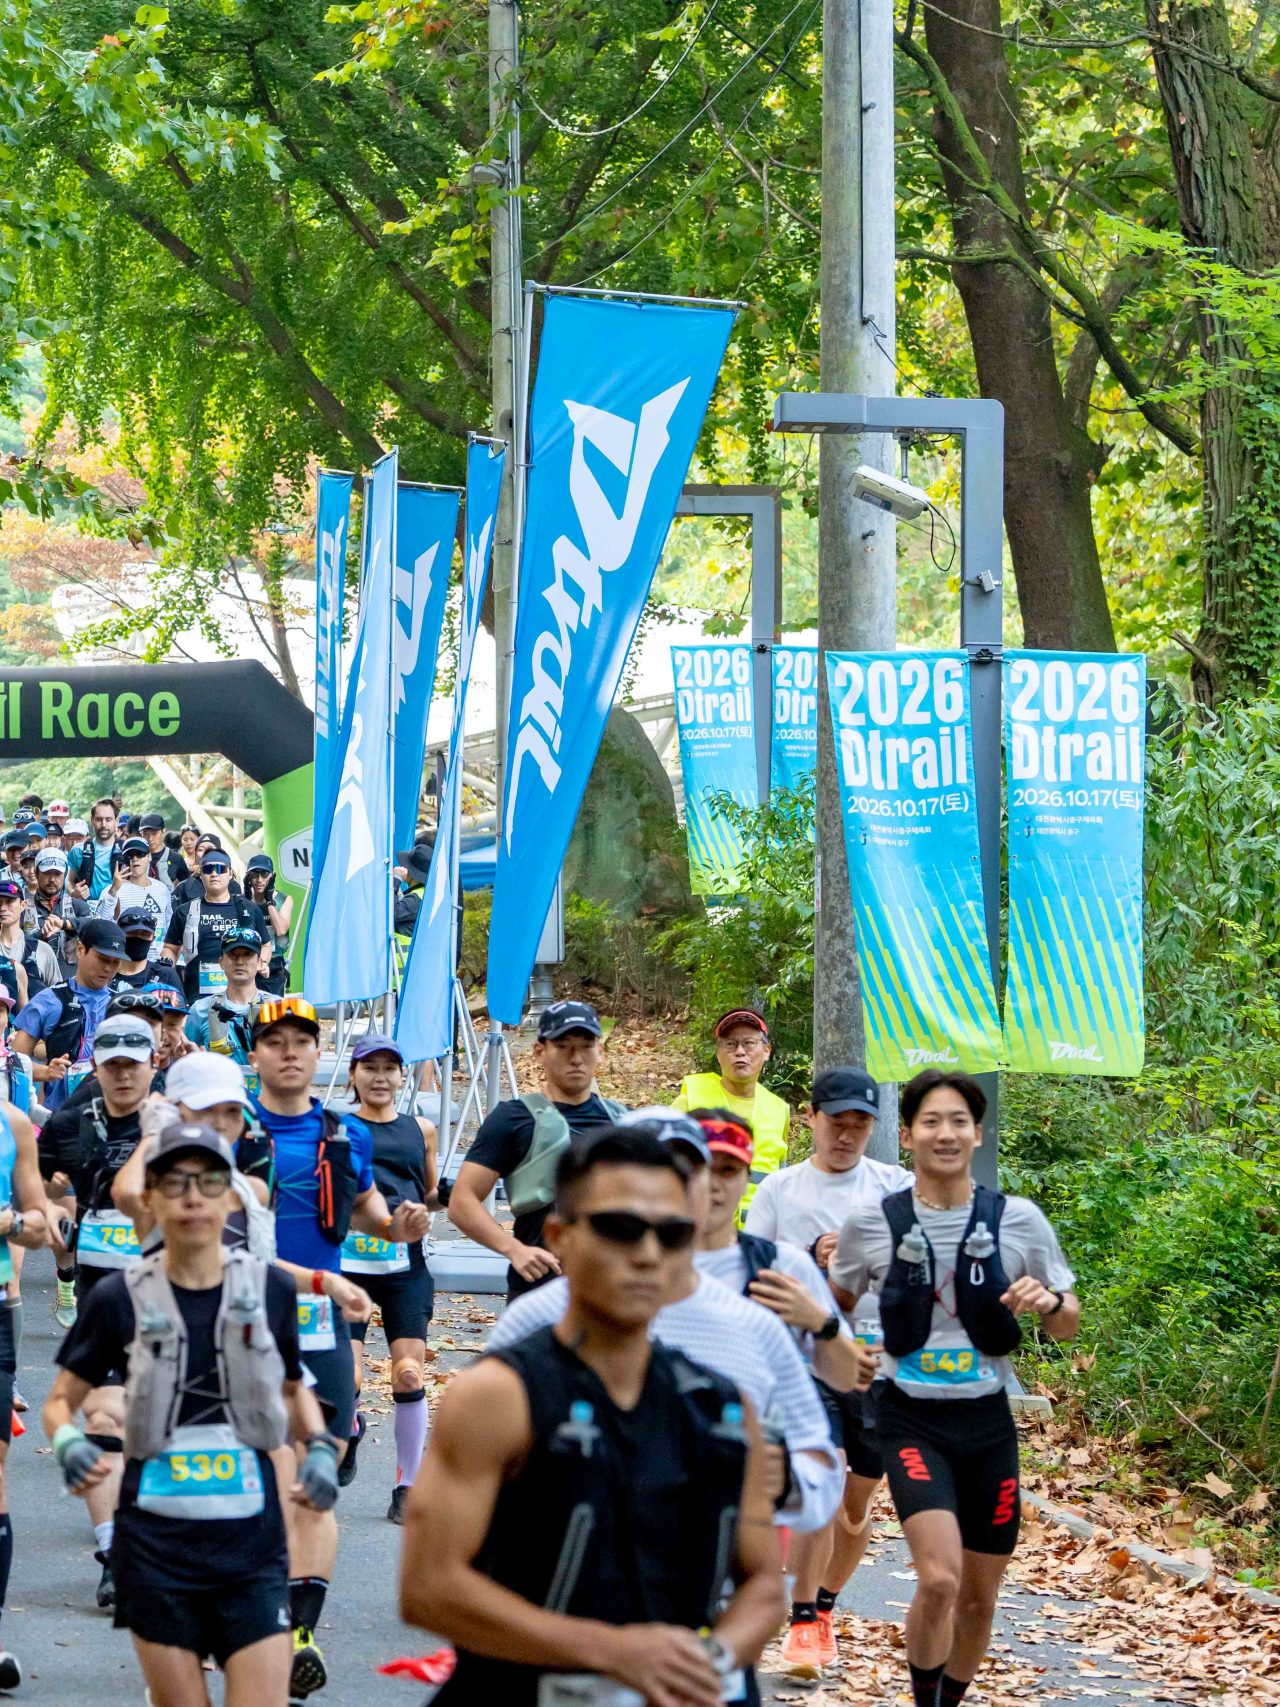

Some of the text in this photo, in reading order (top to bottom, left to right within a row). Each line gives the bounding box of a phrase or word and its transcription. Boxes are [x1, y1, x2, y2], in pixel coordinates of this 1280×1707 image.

[674, 648, 750, 688] 2026
[775, 650, 818, 688] 20
[39, 681, 181, 739] Race
[678, 686, 752, 724] Dtrail
[775, 688, 817, 725] Dtr
[834, 658, 964, 726] 2026
[1010, 659, 1140, 724] 2026
[681, 726, 752, 740] 2026.10.17(토)
[839, 725, 968, 790] Dtrail
[1011, 722, 1141, 784] Dtrail
[847, 791, 970, 817] 2026.10.17(토)
[1013, 788, 1140, 811] 2026.10.17(토)
[355, 1237, 390, 1253] 527
[921, 1351, 973, 1373] 548
[169, 1453, 236, 1481] 530
